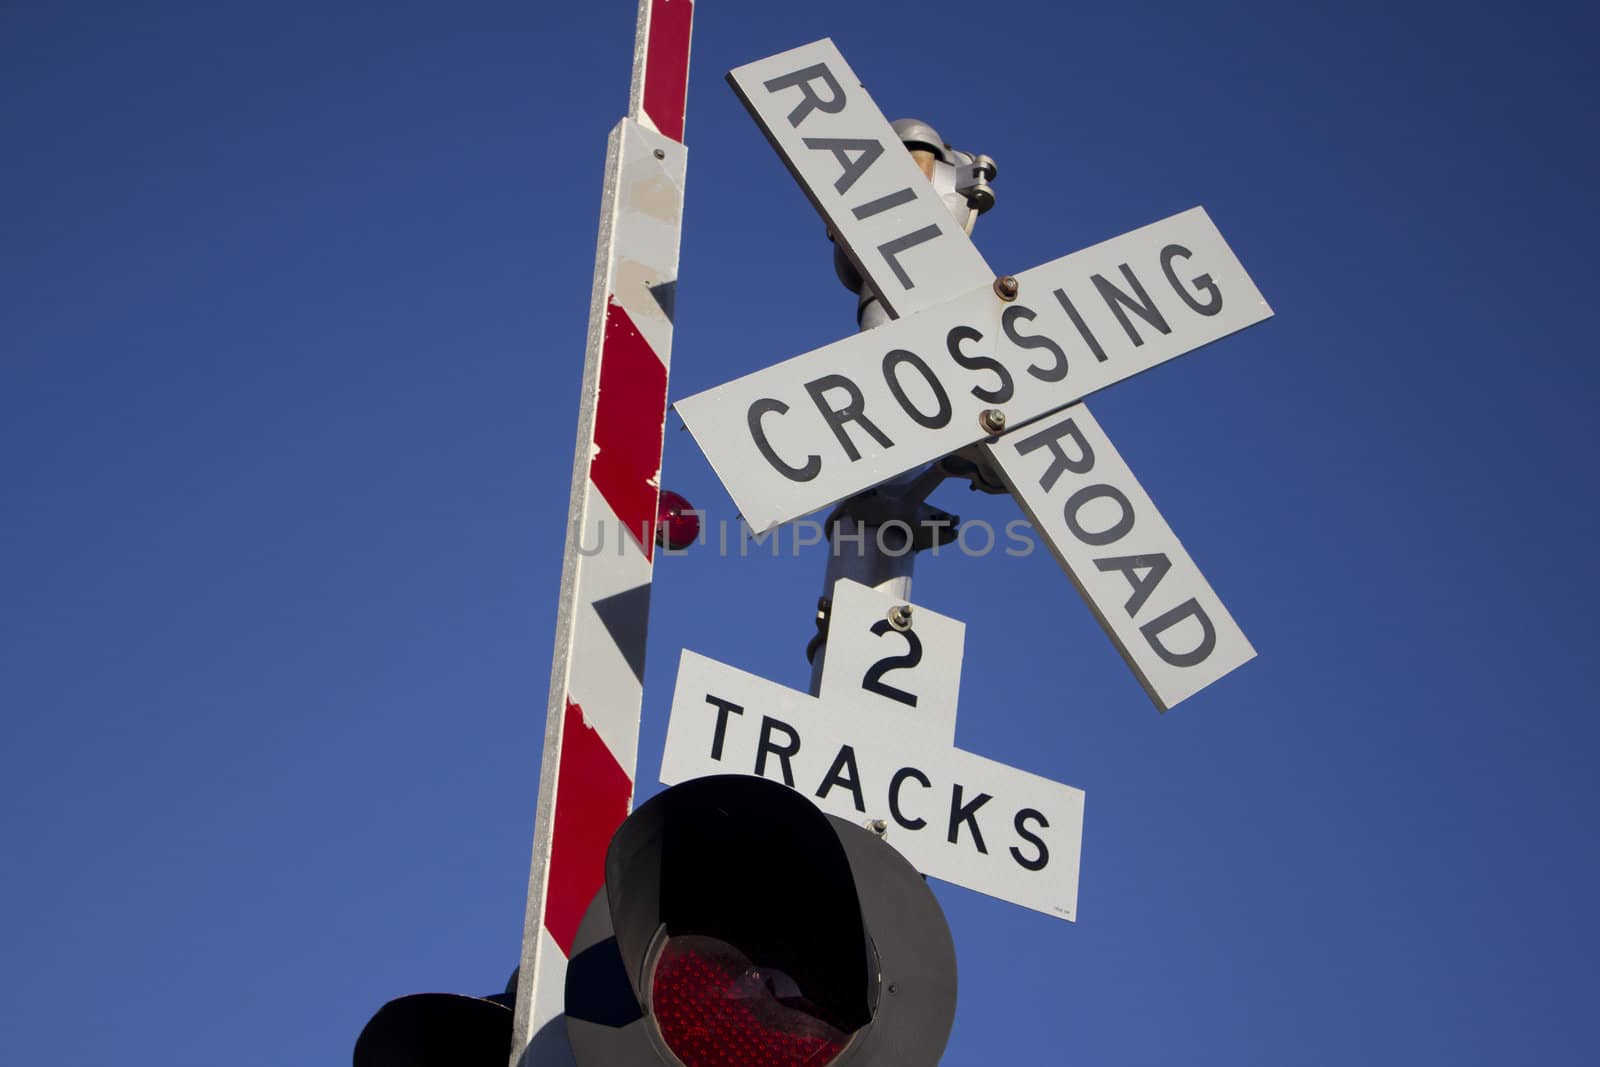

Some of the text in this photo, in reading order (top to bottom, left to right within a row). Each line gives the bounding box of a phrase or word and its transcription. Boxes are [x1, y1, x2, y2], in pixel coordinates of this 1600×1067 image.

[747, 244, 1223, 483] CROSSING
[763, 62, 1217, 668] RAIL ROAD
[862, 619, 923, 708] 2
[705, 693, 1051, 872] TRACKS
